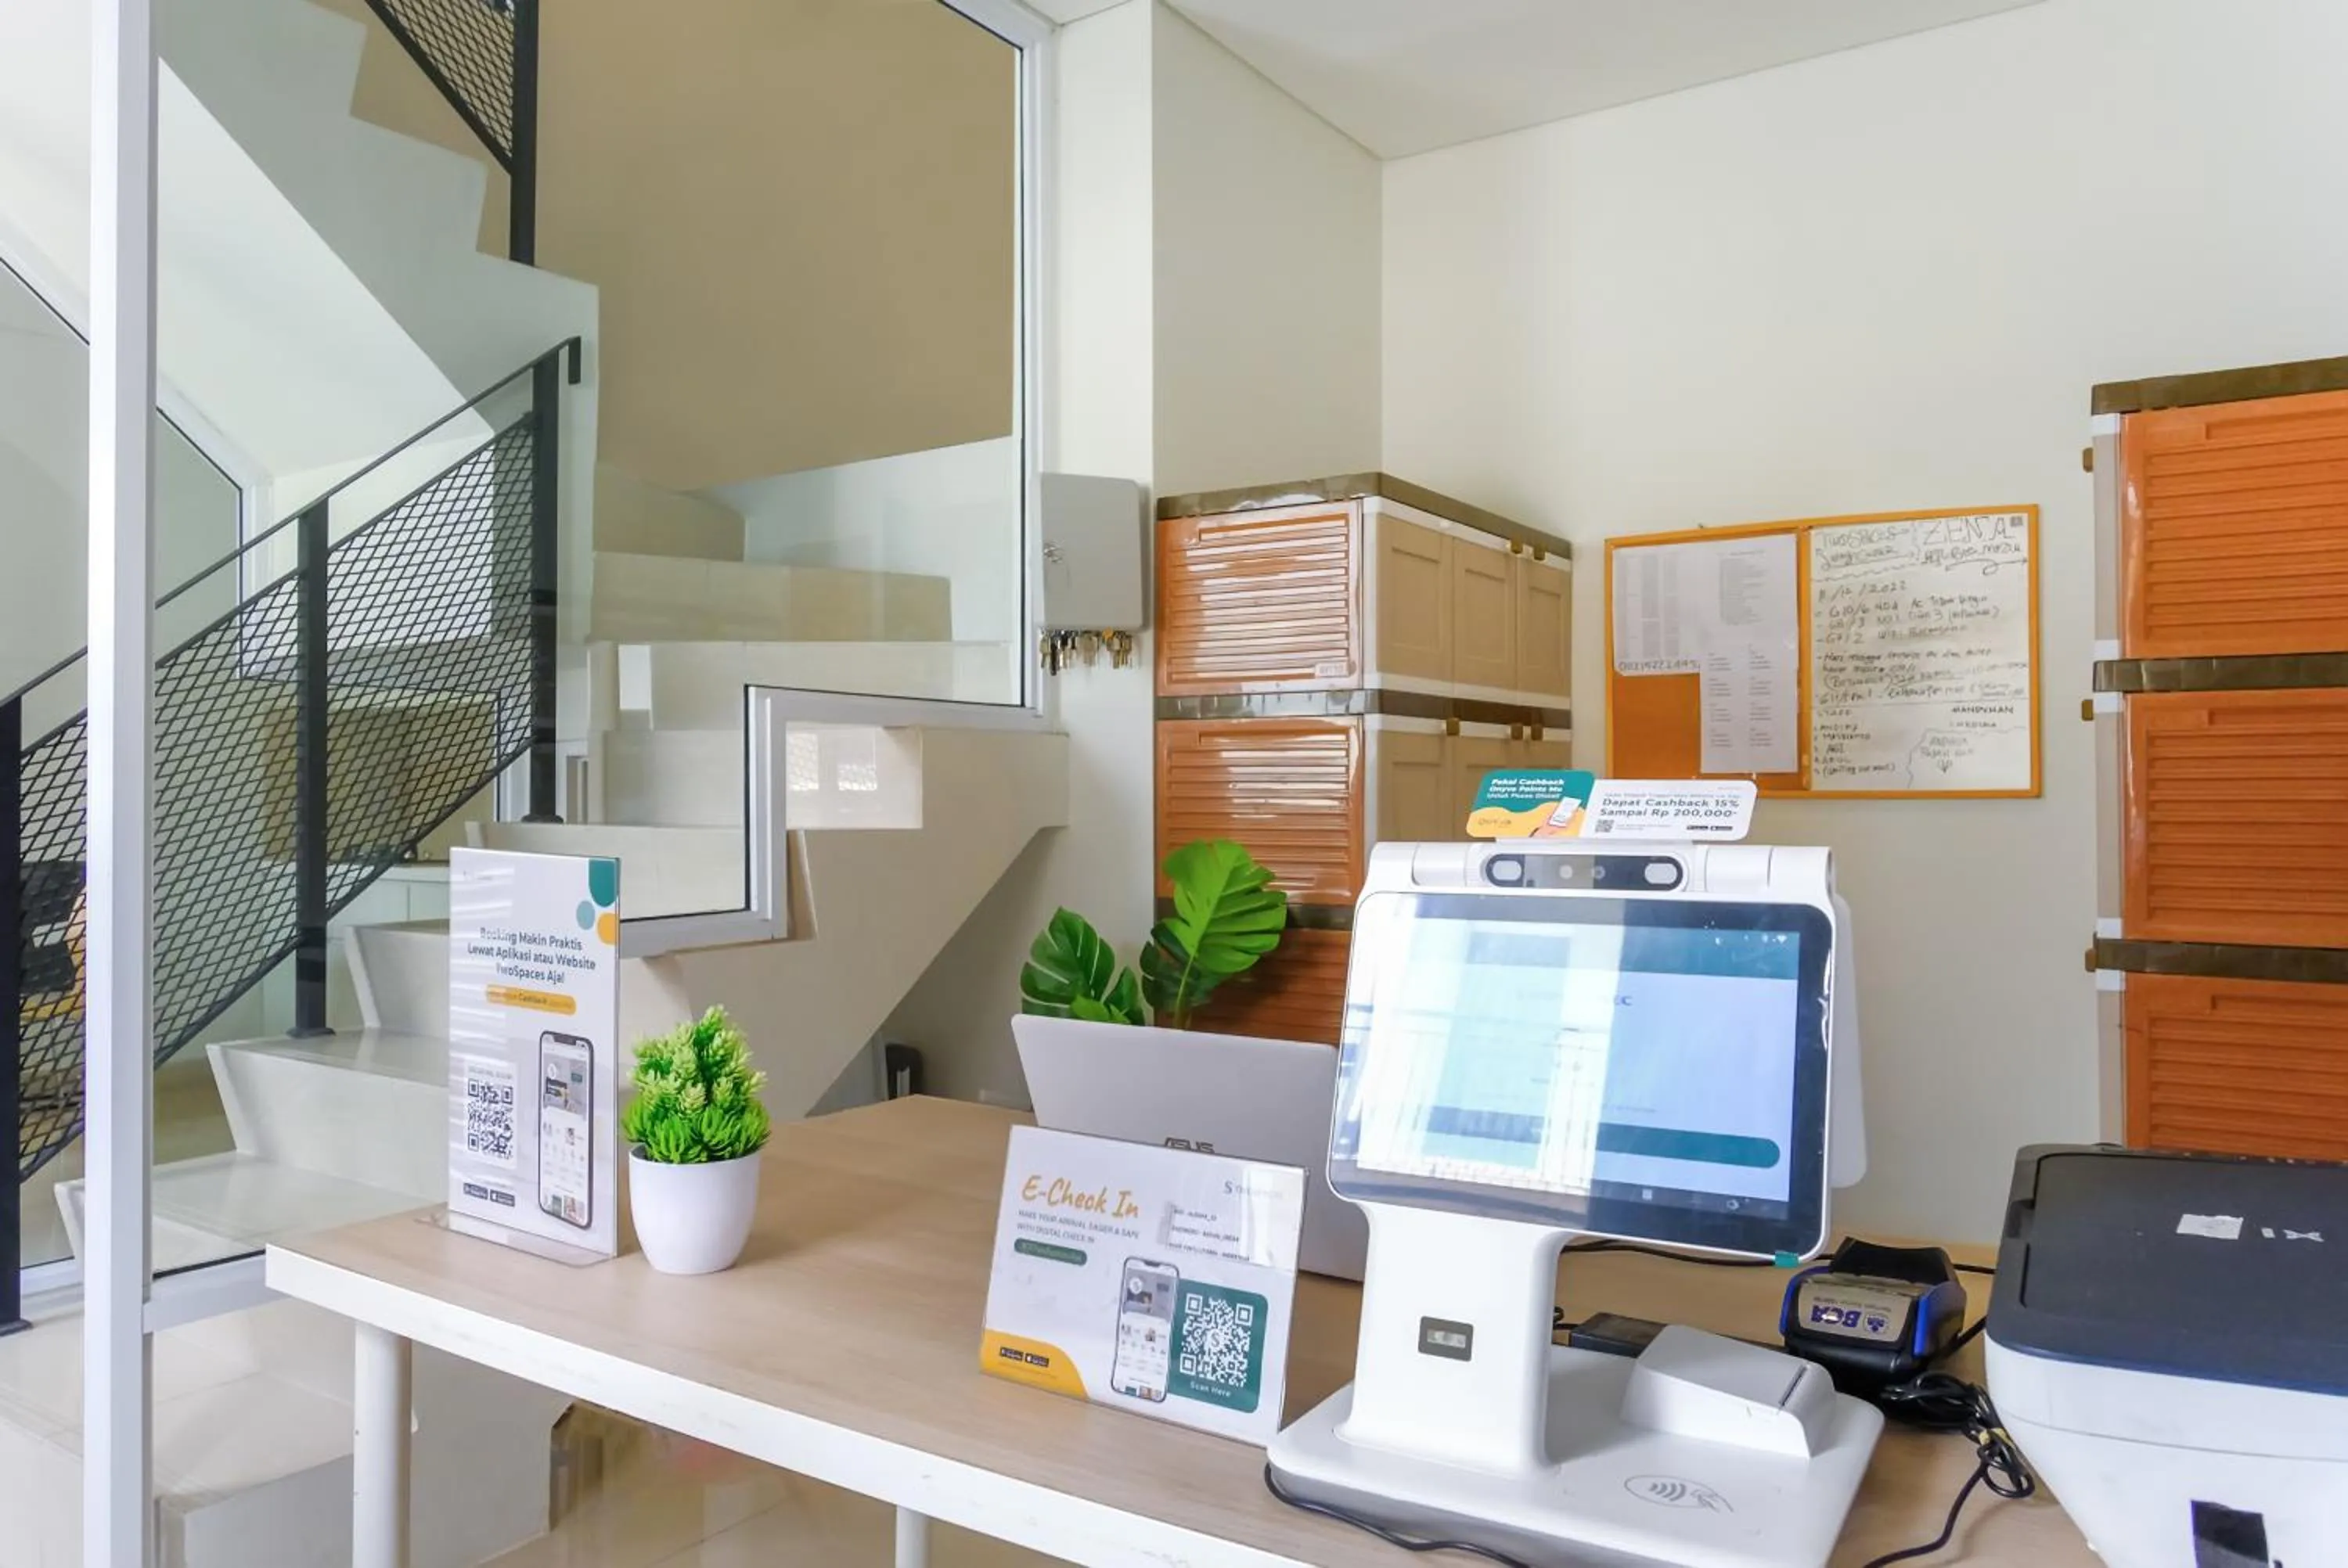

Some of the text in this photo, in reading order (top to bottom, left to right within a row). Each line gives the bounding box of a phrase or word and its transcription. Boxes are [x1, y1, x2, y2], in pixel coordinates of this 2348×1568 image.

[1600, 807, 1647, 818] Sampai
[1651, 809, 1669, 818] Rp
[1602, 798, 1740, 807] Dapat Cashback 15%
[519, 931, 547, 946] Makin
[549, 935, 582, 951] Praktis
[467, 942, 596, 970] Lewat Aplikasi atau Website
[1021, 1174, 1107, 1214] E-Check
[1111, 1189, 1140, 1218] In
[1810, 1304, 1862, 1329] BCA
[1190, 1380, 1231, 1398] Scan Here
